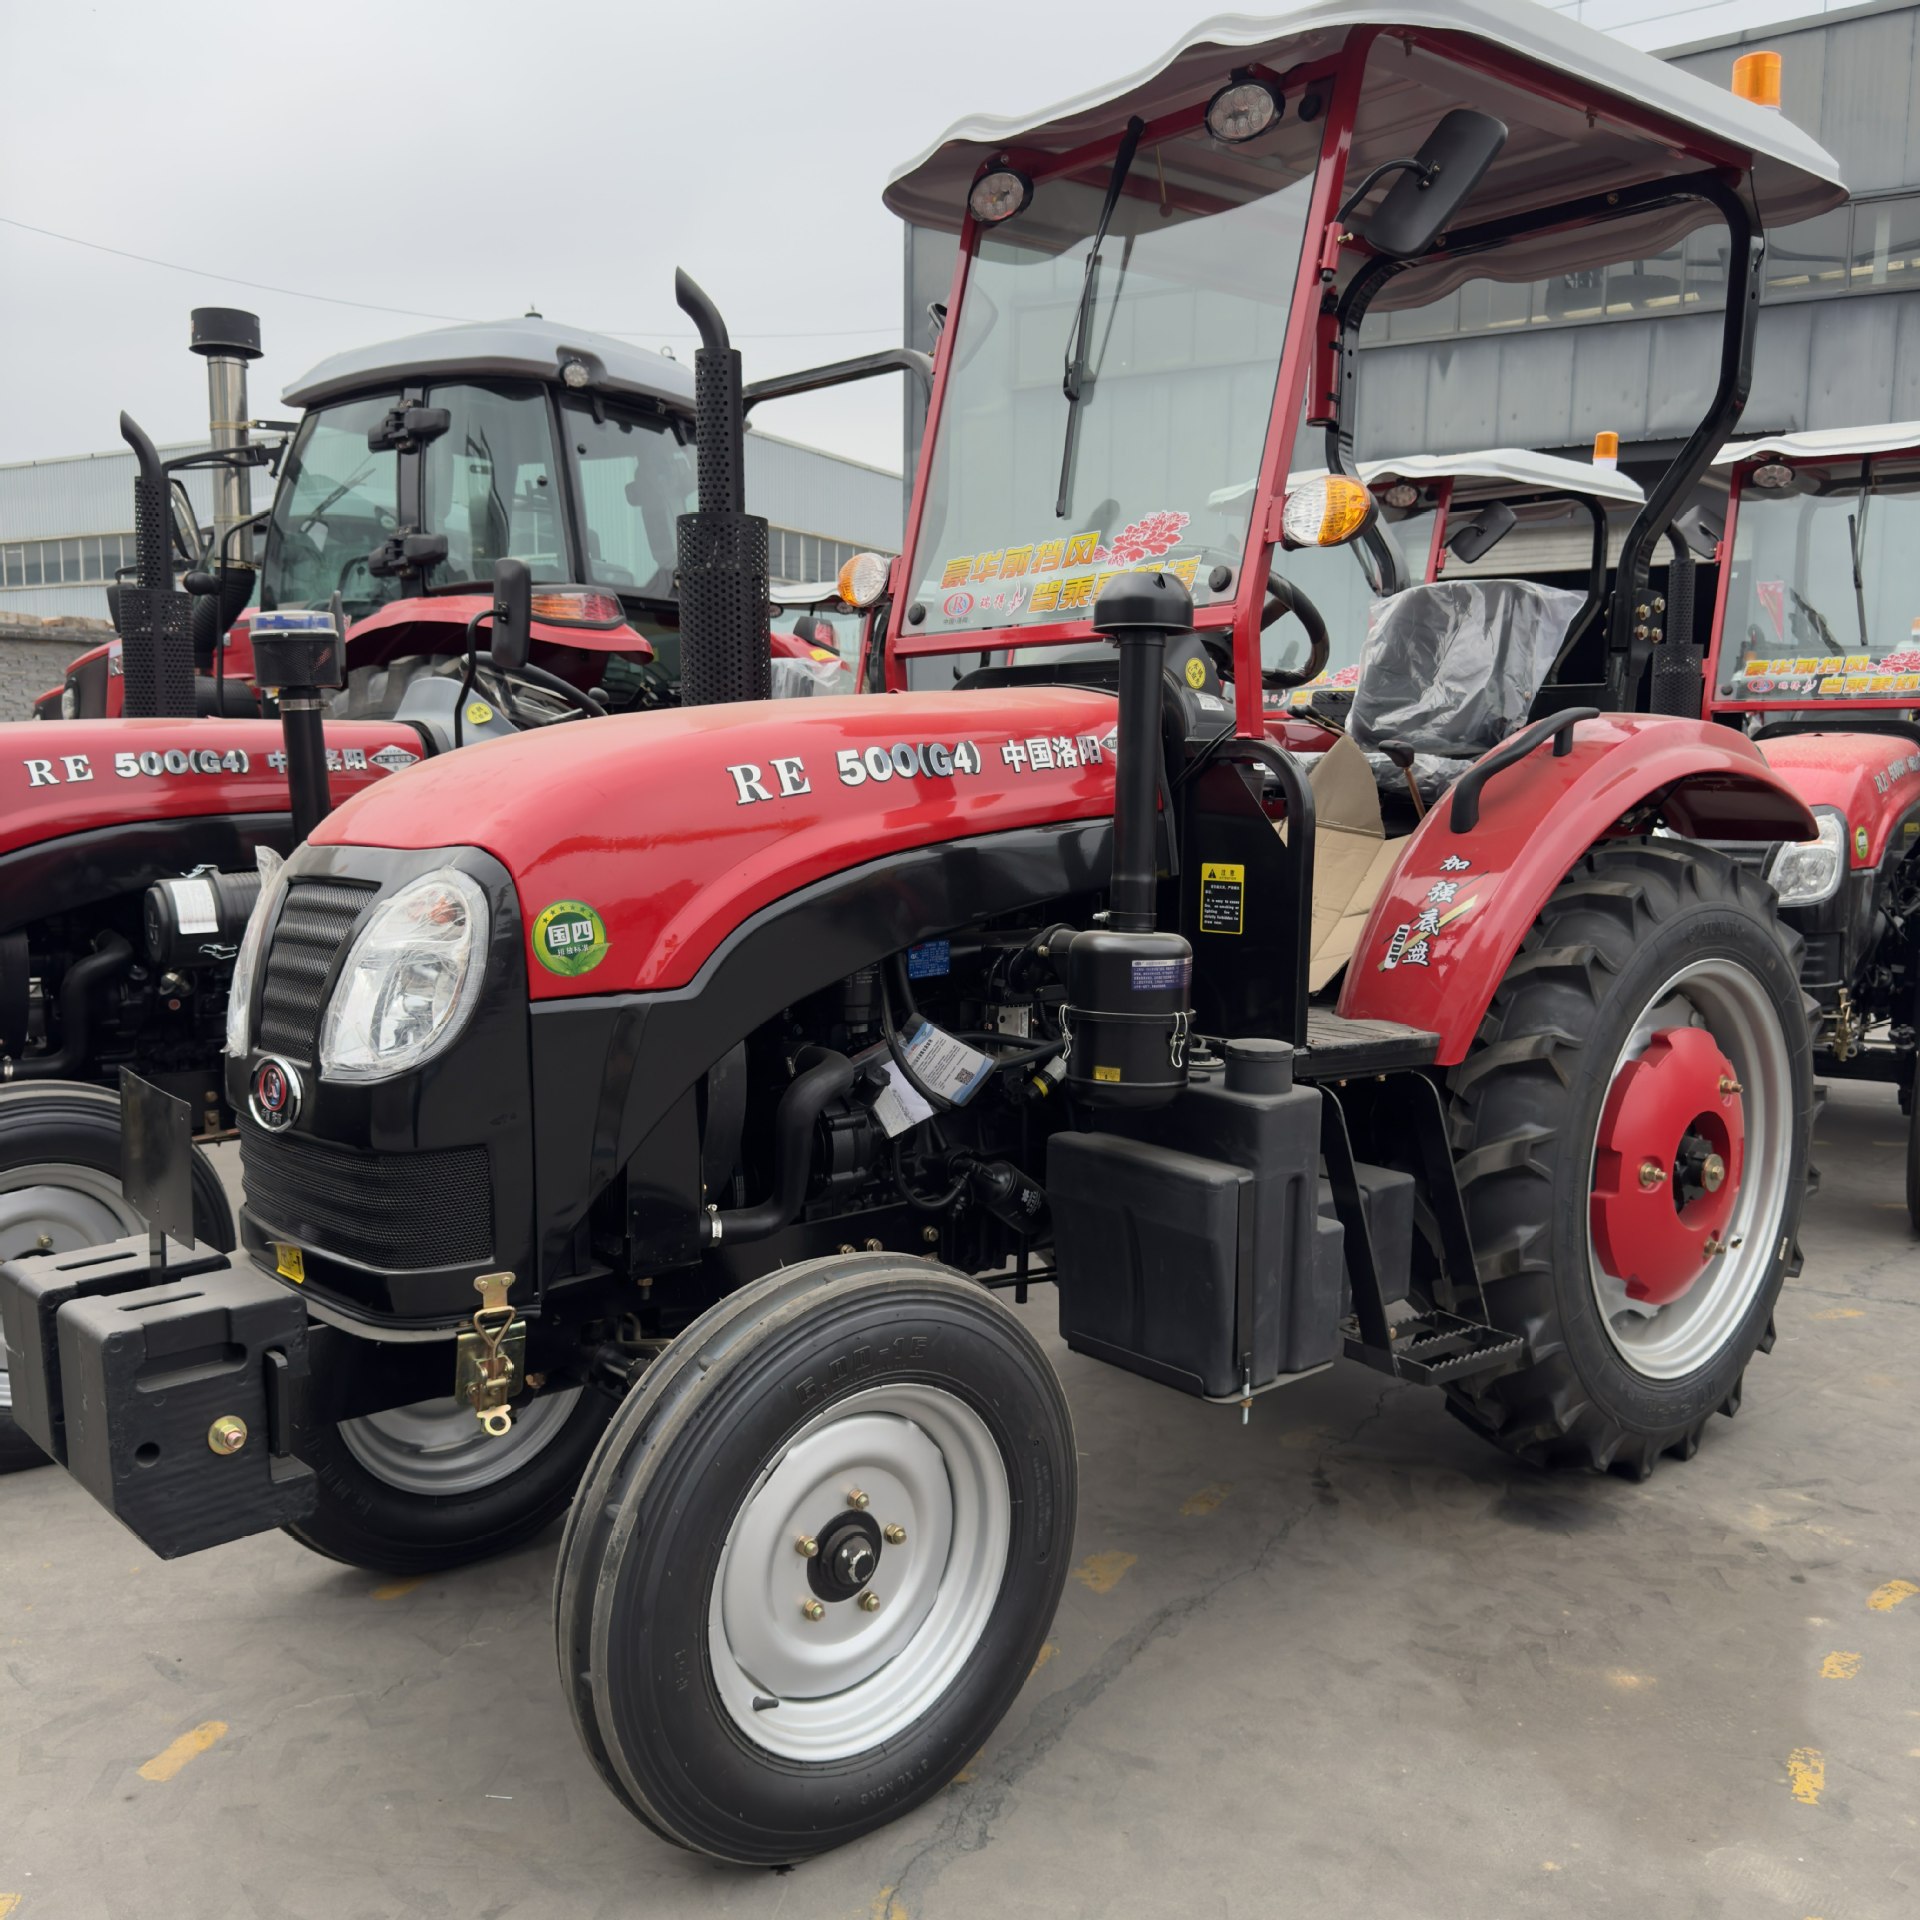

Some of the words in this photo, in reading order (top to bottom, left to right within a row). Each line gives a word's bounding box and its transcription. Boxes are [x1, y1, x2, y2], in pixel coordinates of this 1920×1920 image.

[940, 531, 1101, 590] 豪华前挡风
[114, 748, 249, 778] 500(G4)
[266, 748, 368, 774] 中洛阳
[835, 740, 981, 787] 500(G4)
[1000, 734, 1103, 774] 中国洛阳
[1402, 855, 1471, 967] 加强底盘
[547, 920, 594, 948] 国四
